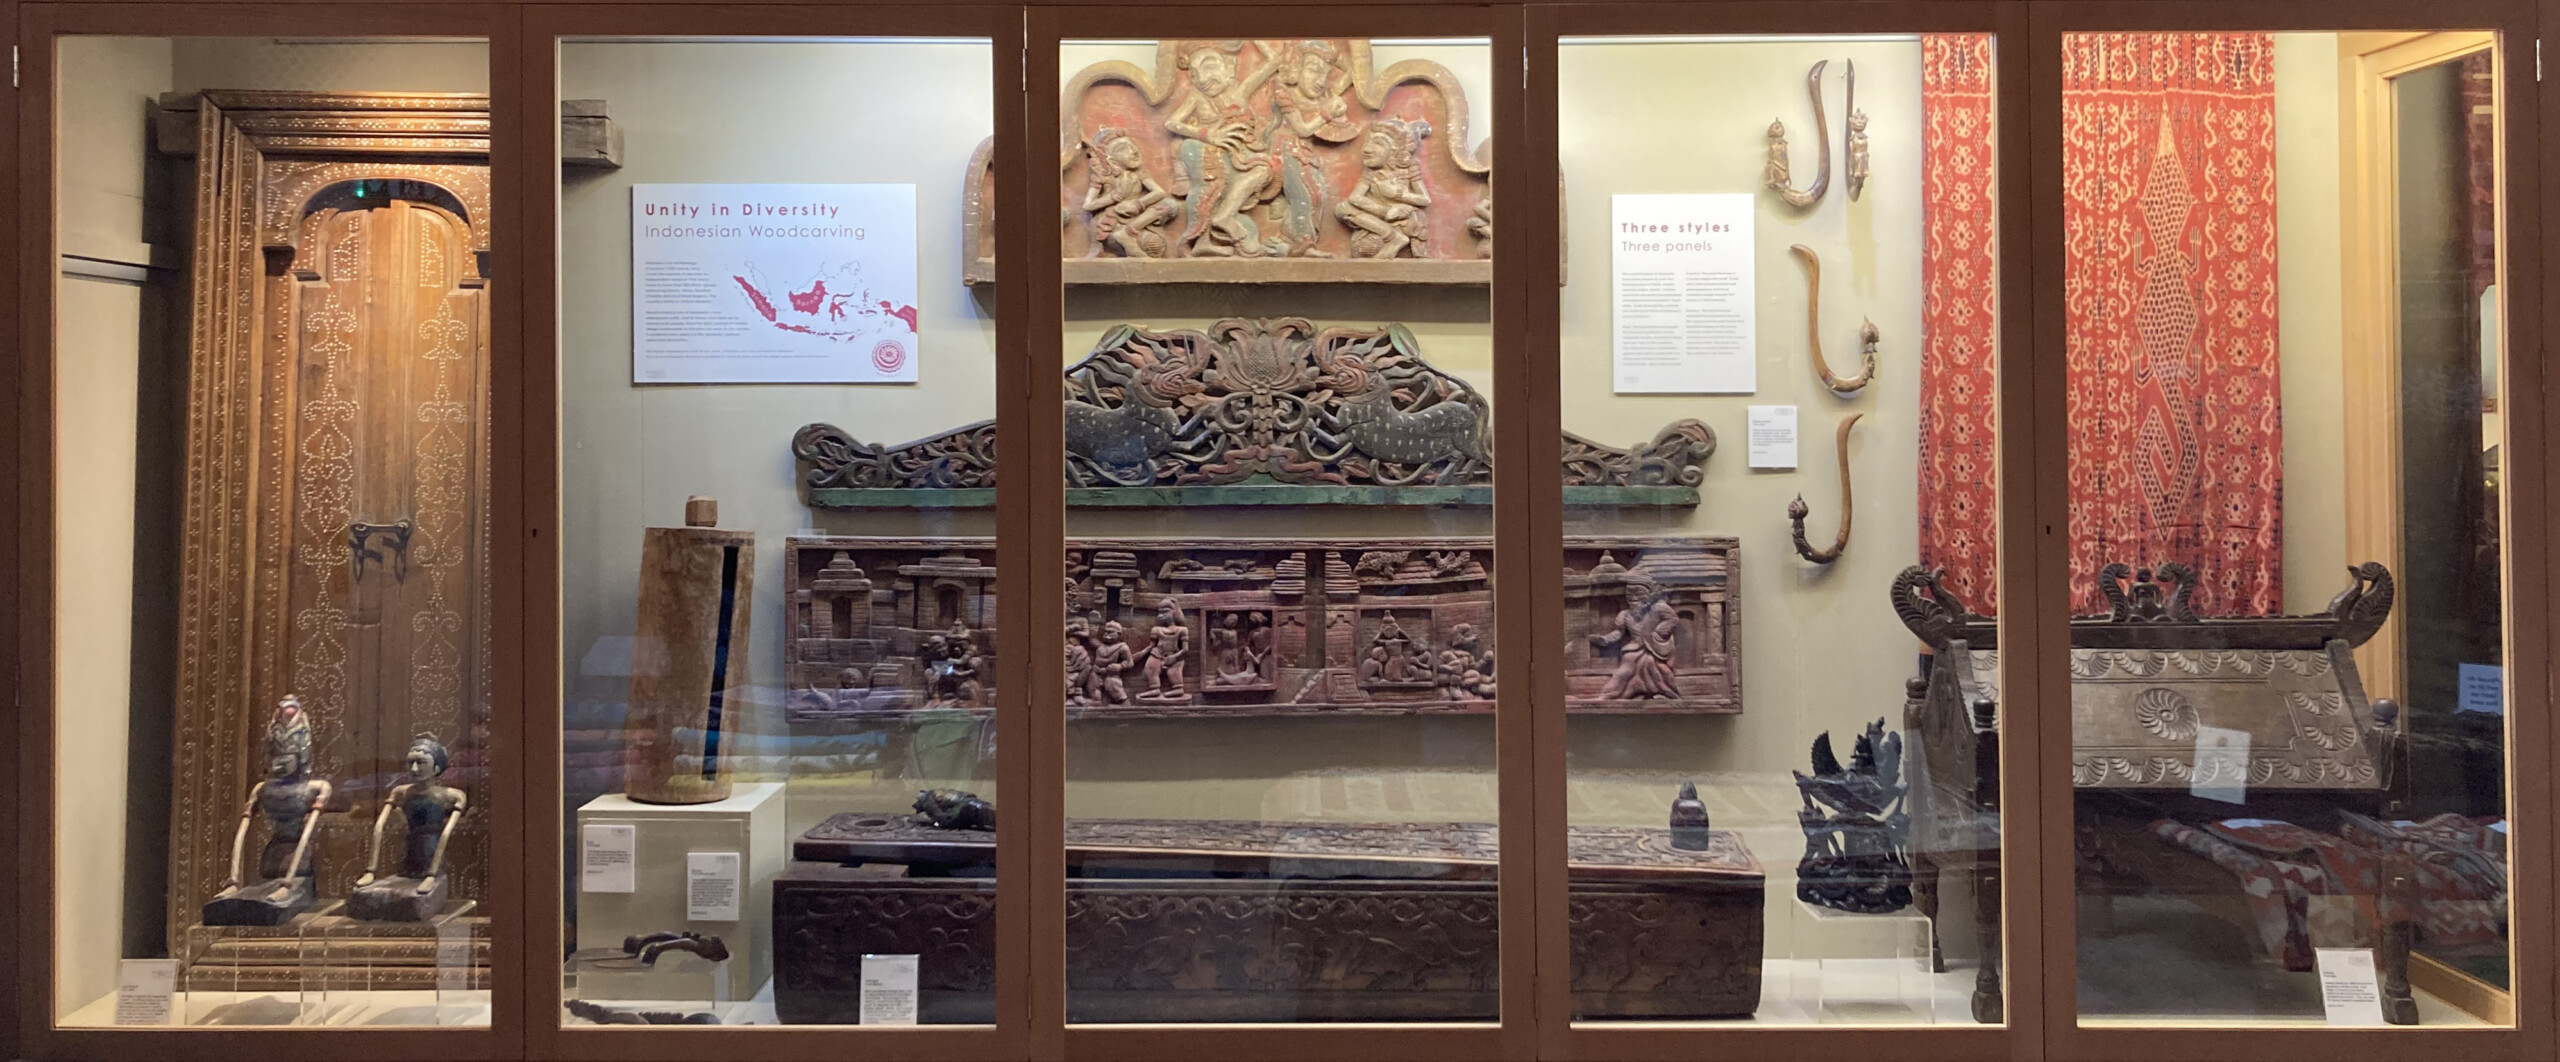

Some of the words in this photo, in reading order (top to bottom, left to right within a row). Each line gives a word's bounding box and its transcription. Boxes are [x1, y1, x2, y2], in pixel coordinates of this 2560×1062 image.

[646, 203, 700, 219] Unity
[711, 203, 730, 216] in
[742, 203, 840, 219] Diversity
[645, 225, 741, 238] Indonesian
[748, 225, 865, 241] Woodcarving
[1621, 222, 1670, 234] Three
[1678, 222, 1731, 235] styles
[1621, 241, 1661, 252] Three
[1665, 241, 1713, 254] panels
[796, 290, 821, 307] Borneo
